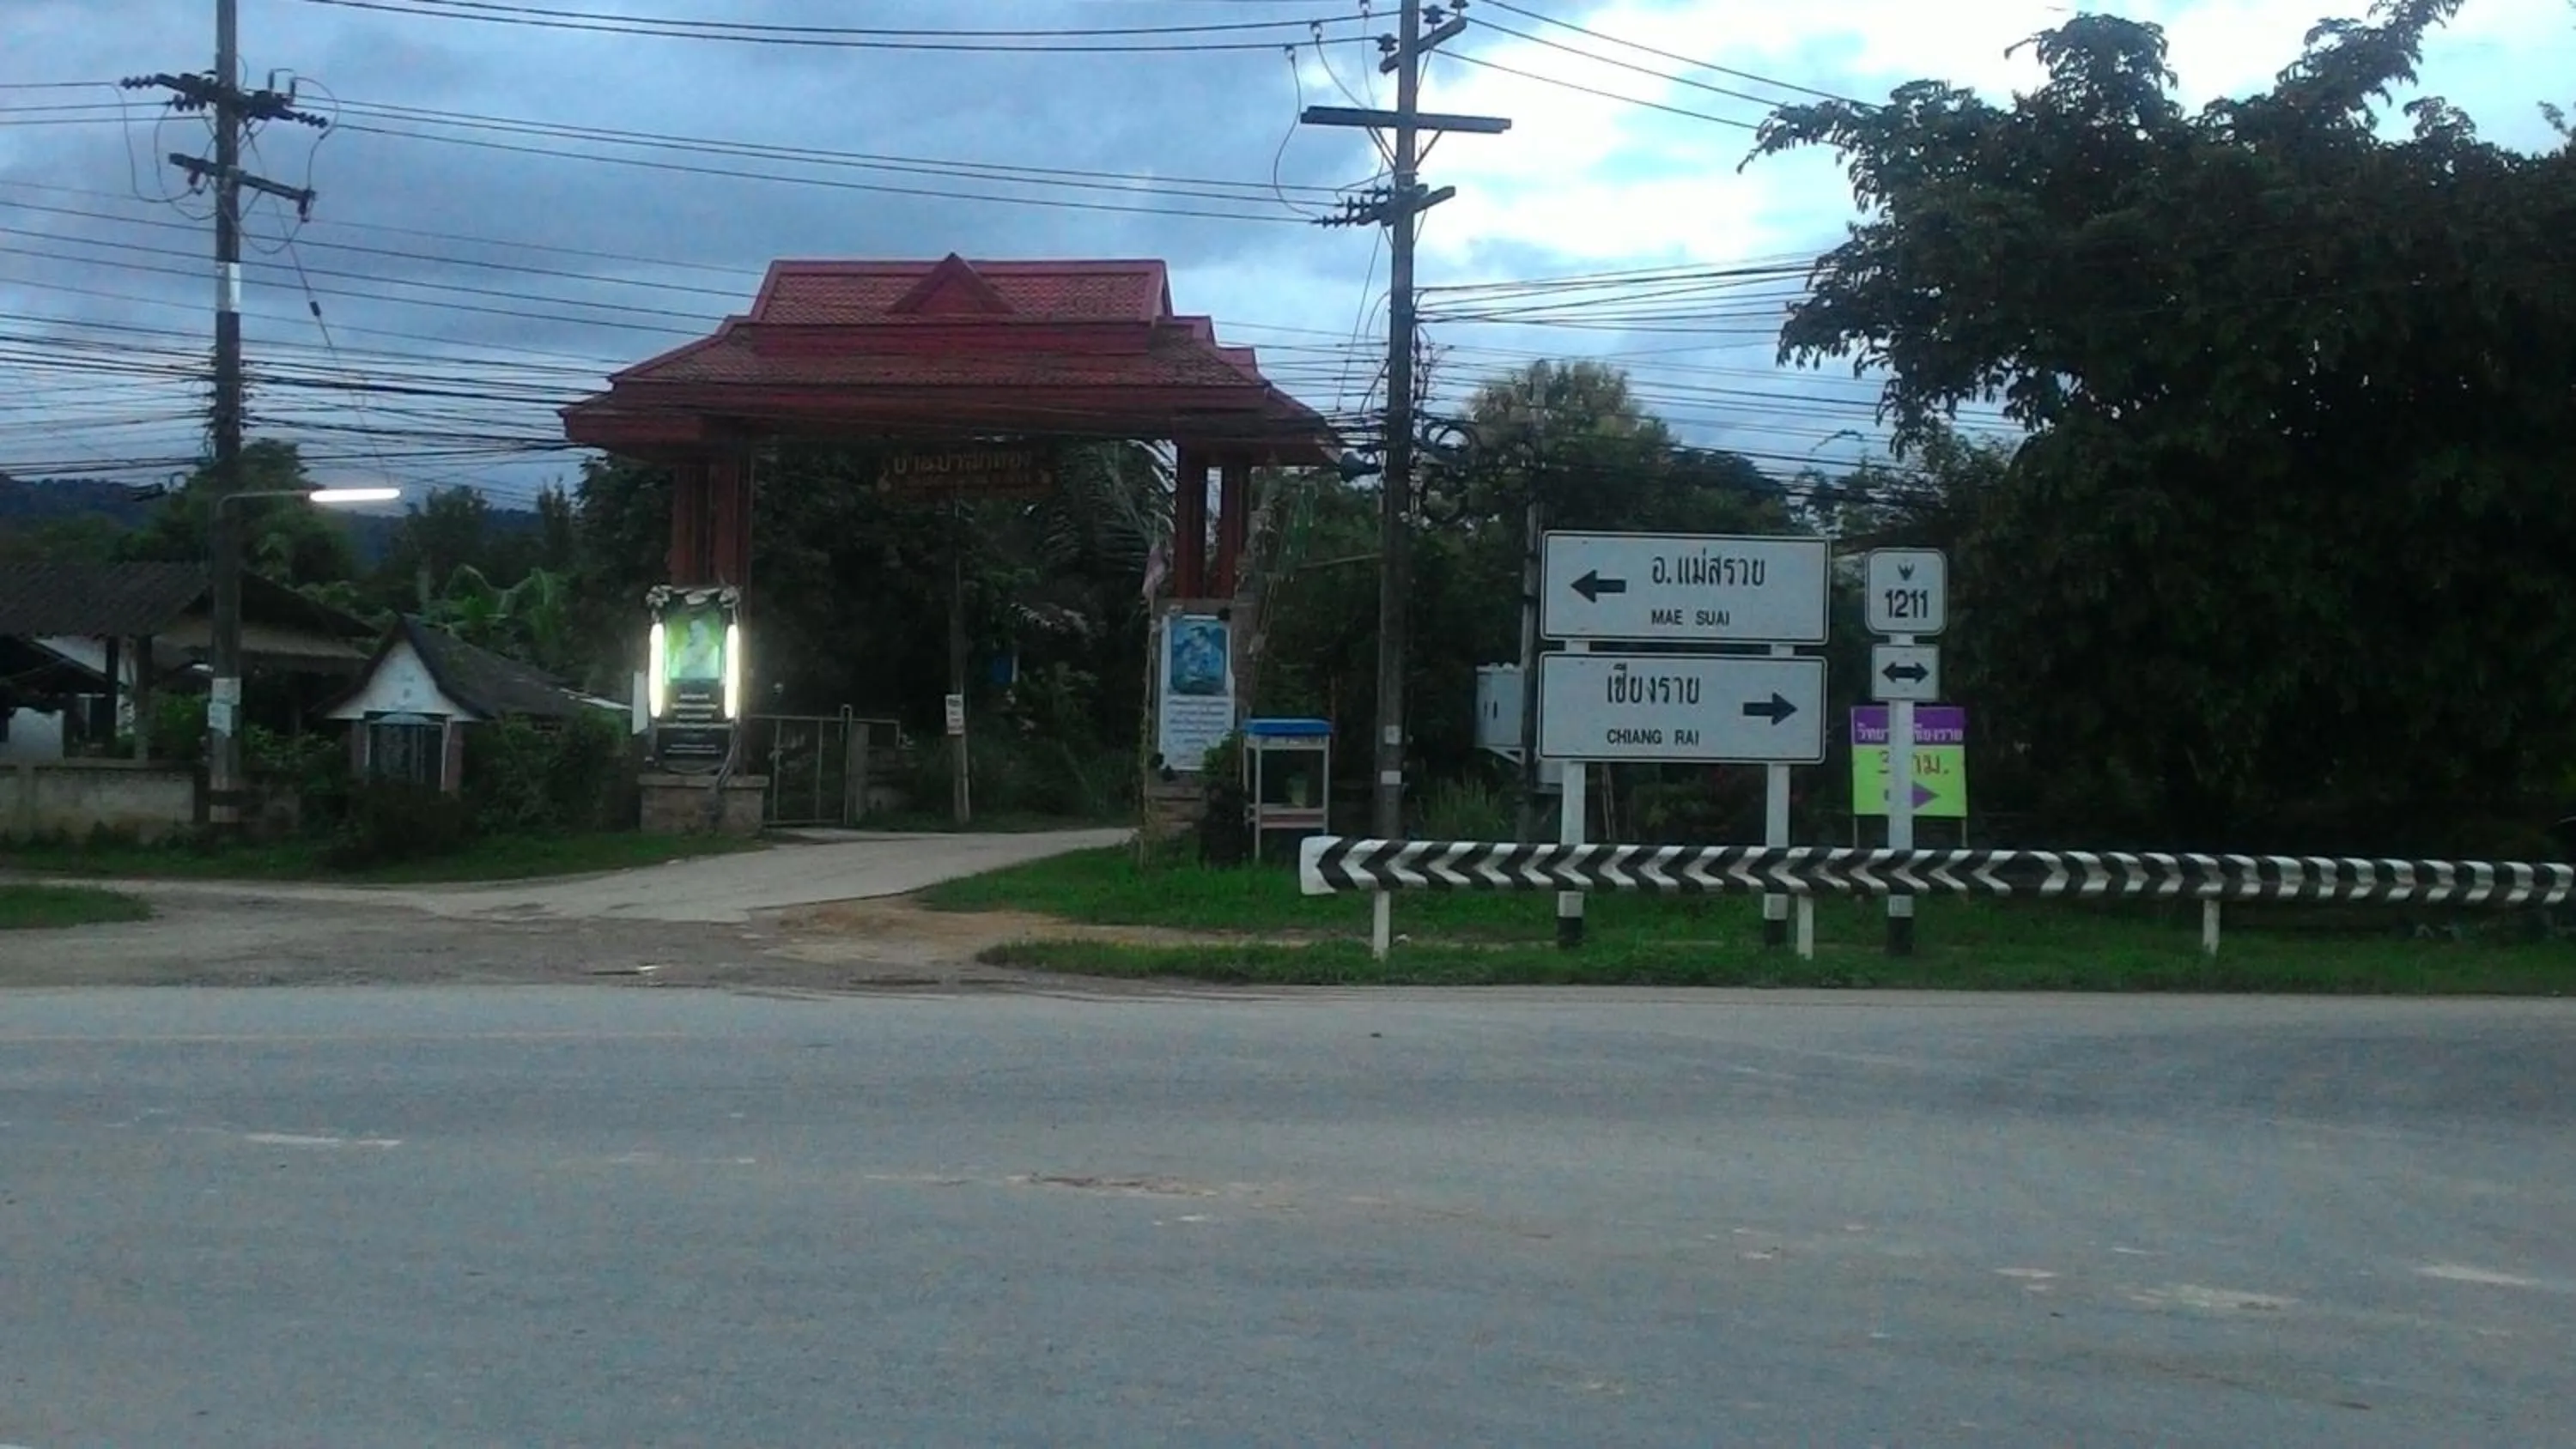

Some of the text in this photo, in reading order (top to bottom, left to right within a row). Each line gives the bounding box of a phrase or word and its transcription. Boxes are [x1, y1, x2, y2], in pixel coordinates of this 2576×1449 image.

[1651, 547, 1766, 586] อ.แม่สรวย
[1650, 609, 1730, 626] MAE SUAI
[1885, 589, 1928, 619] 1211
[1607, 662, 1700, 704] เชียงราย
[1607, 728, 1700, 746] CHIANG RAI
